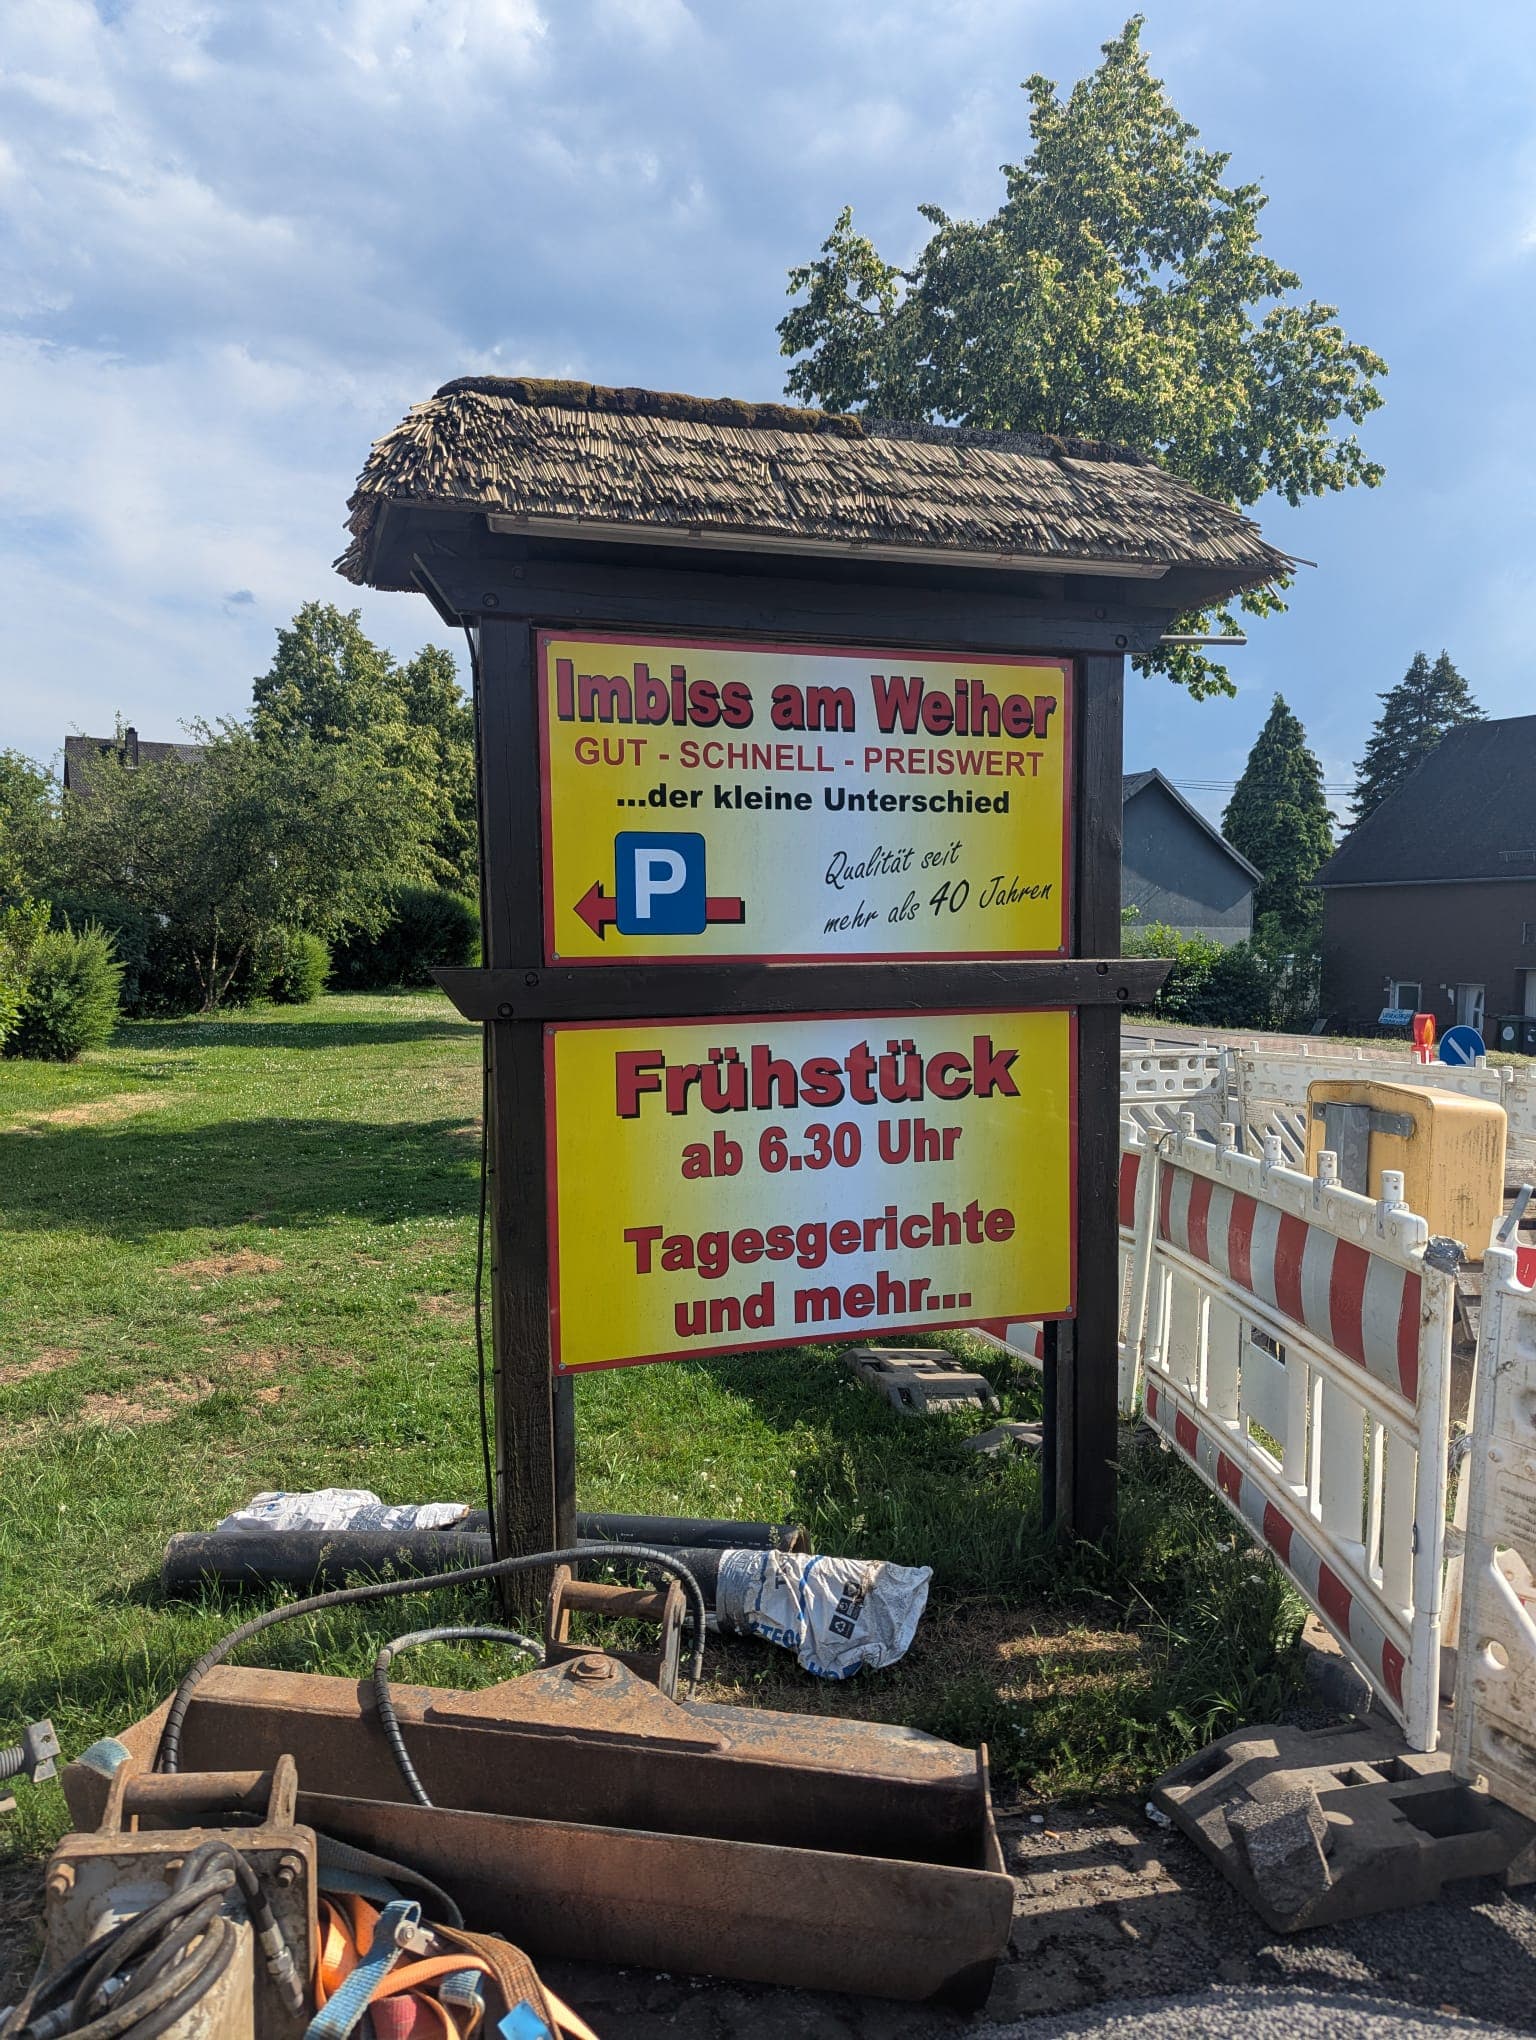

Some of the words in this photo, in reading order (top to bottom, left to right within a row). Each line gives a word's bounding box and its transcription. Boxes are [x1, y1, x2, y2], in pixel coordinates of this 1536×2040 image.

[556, 658, 753, 729] Imbiss
[771, 684, 856, 732] am
[871, 675, 1057, 738] Weiher
[575, 737, 647, 766] GUT
[680, 741, 834, 772] SCHNELL
[865, 747, 1044, 777] PREISWERT
[617, 783, 703, 809] ...der
[714, 785, 812, 811] kleine
[825, 787, 1009, 813] Unterschied
[634, 848, 687, 919] P
[825, 846, 914, 890] Qualität
[921, 840, 962, 869] seit
[824, 900, 878, 934] mehr
[888, 890, 920, 923] als
[929, 879, 969, 916] 40
[979, 876, 1052, 908] Jahren
[615, 1035, 1020, 1118] Frühstück
[681, 1131, 743, 1180] ab
[759, 1122, 861, 1173] 6.30
[878, 1118, 962, 1165] Uhr
[624, 1199, 1015, 1279] Tagesgerichte
[674, 1281, 774, 1337] und
[795, 1270, 971, 1324] mehr...
